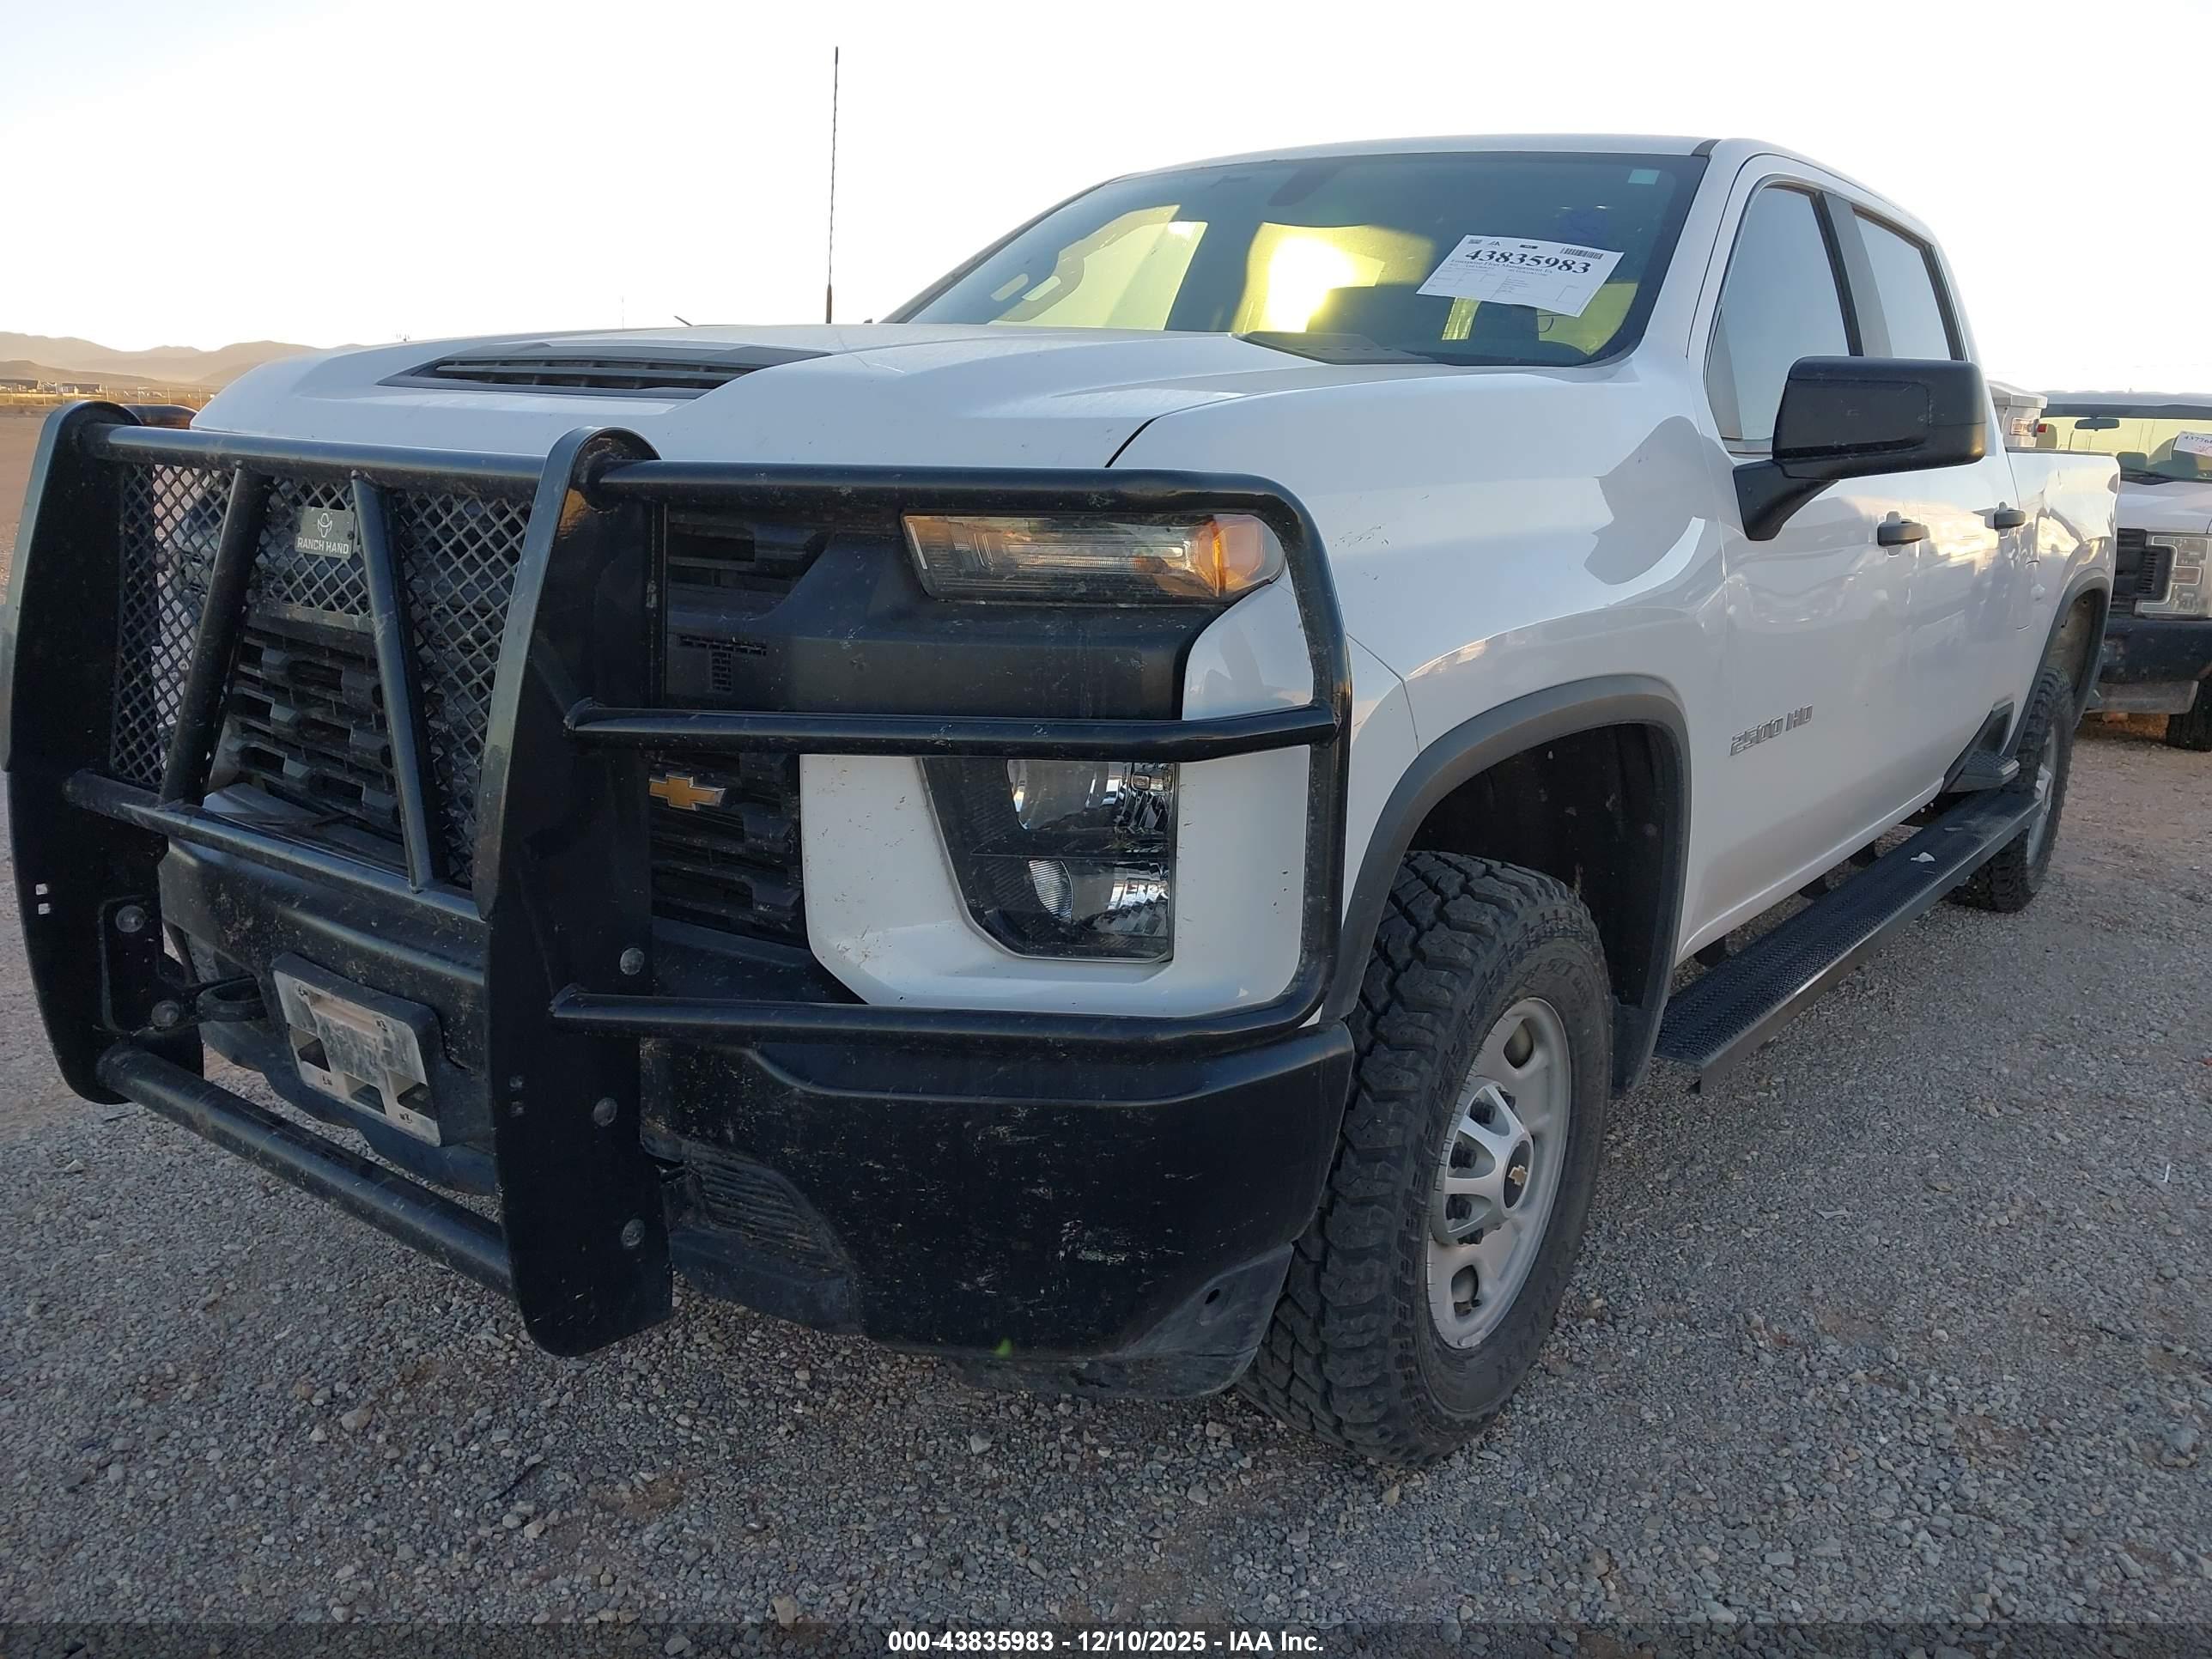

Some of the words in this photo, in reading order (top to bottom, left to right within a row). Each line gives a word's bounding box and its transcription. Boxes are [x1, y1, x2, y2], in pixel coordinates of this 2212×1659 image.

[1465, 249, 1591, 274] 43835983
[297, 537, 325, 551] RANCH
[326, 541, 349, 555] HAND
[1729, 716, 1784, 757] 2500
[1786, 703, 1814, 732] HD
